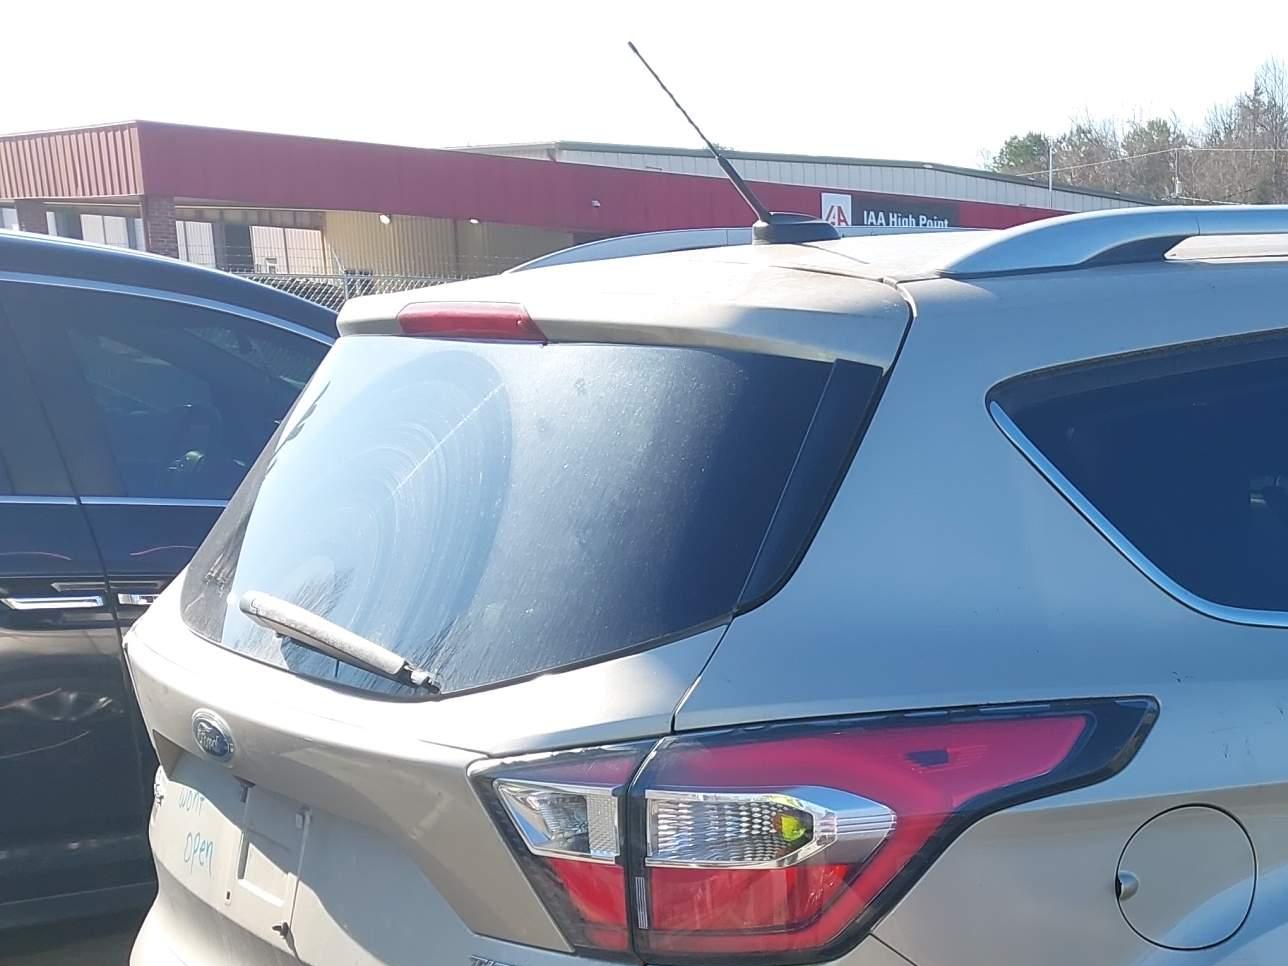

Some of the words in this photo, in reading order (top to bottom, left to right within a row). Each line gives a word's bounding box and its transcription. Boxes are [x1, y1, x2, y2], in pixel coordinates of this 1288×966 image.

[863, 210, 886, 225] IAA
[889, 213, 916, 227] High
[919, 215, 949, 228] Point
